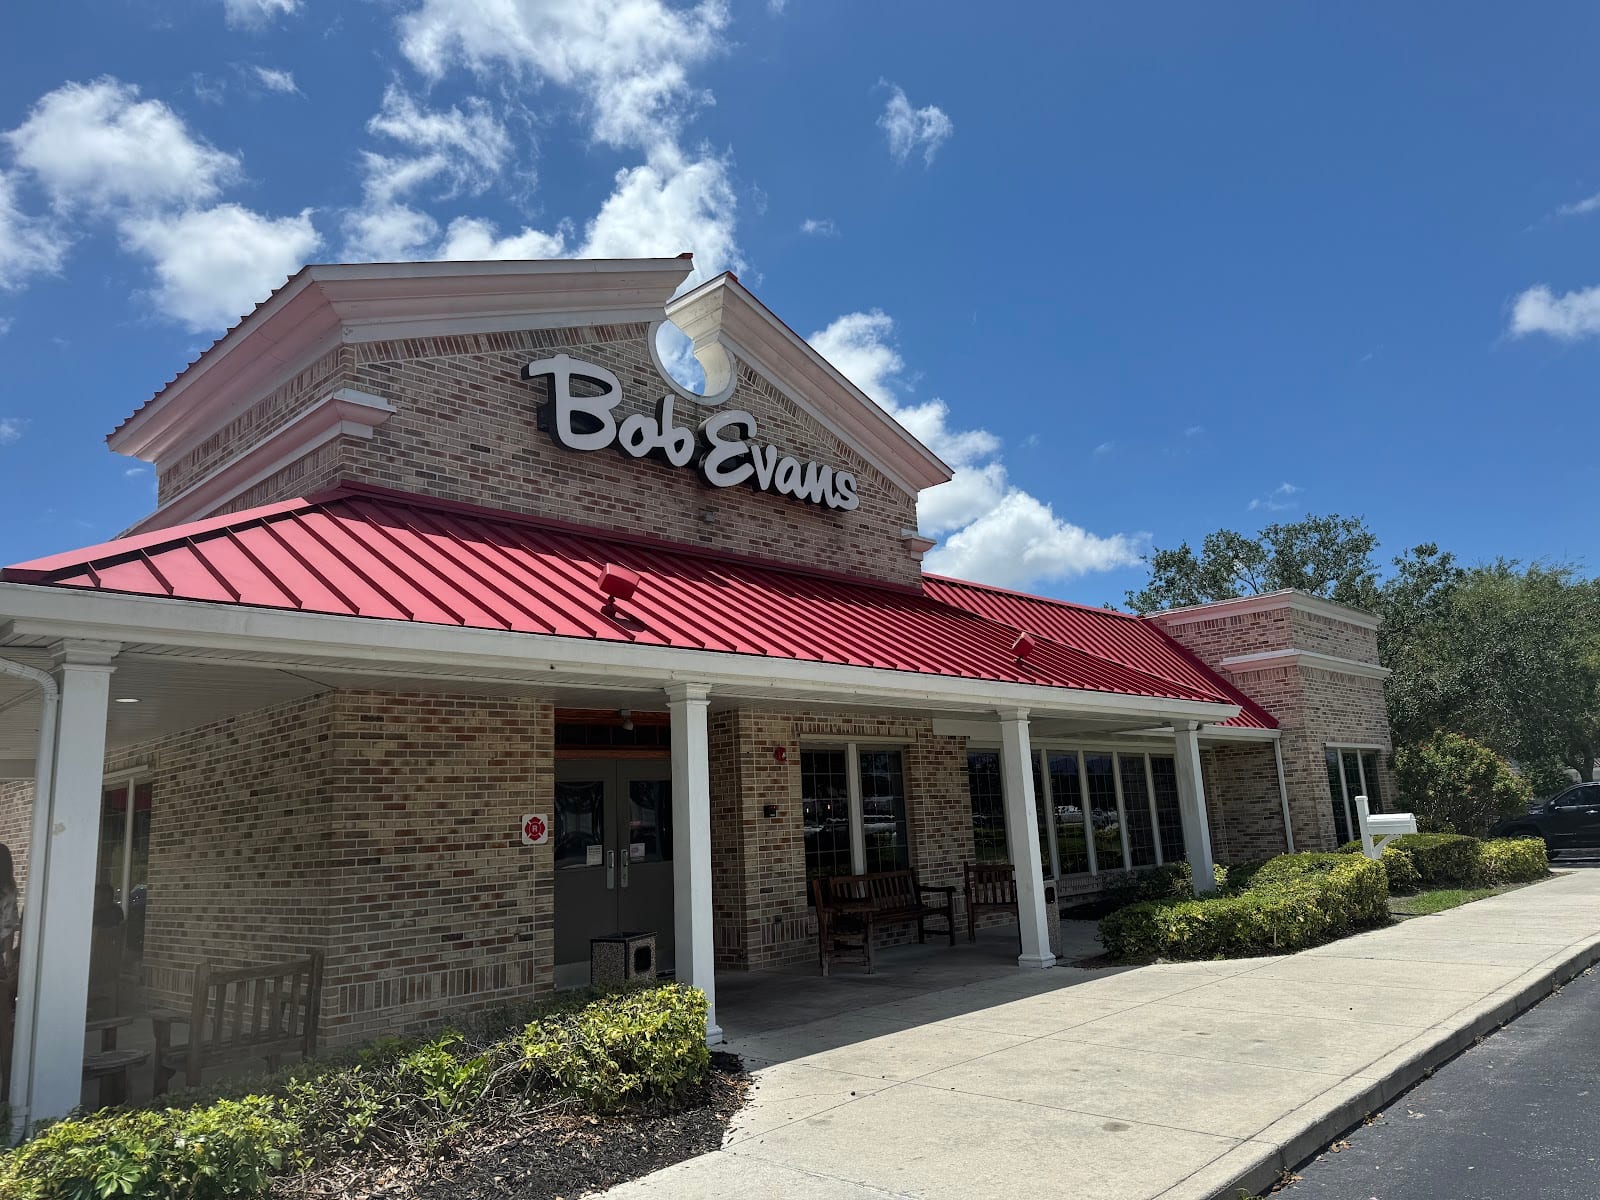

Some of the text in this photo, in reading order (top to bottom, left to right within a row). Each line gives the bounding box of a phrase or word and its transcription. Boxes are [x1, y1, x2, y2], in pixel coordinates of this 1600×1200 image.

[524, 353, 860, 511] Bob Evans
[532, 824, 538, 832] R
